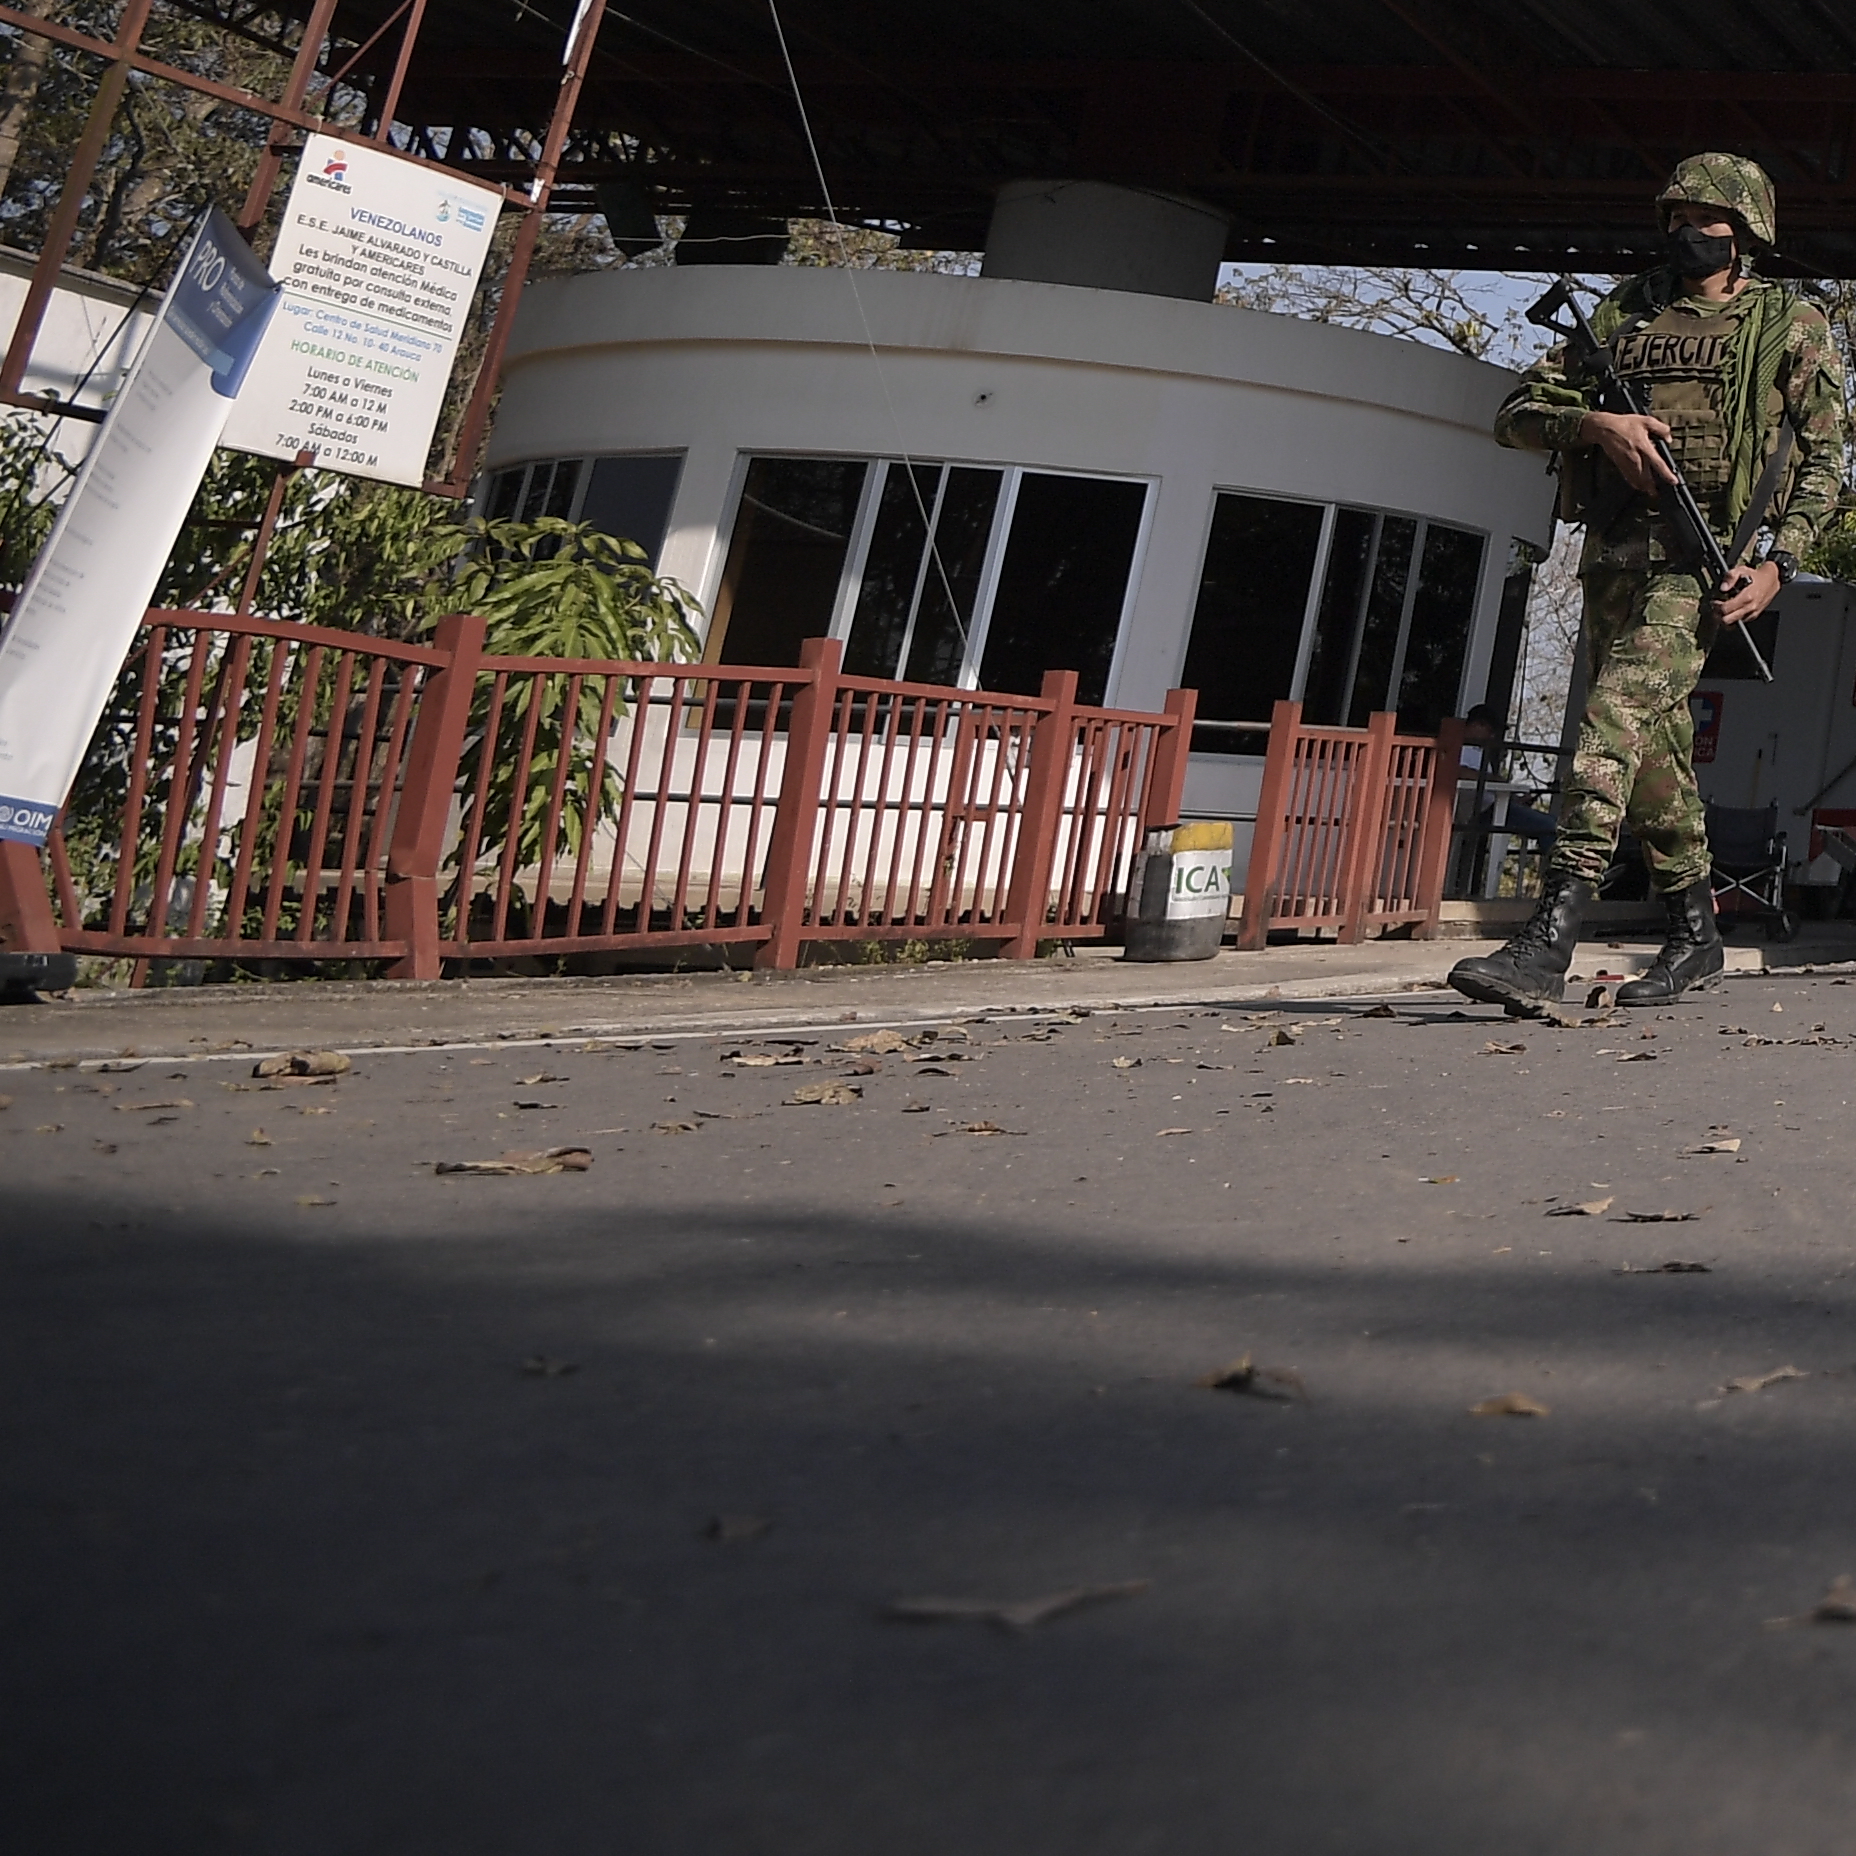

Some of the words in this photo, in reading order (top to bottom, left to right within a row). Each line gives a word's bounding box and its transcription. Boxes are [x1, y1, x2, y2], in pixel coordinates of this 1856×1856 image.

[307, 175, 351, 194] americares
[351, 207, 442, 246] VENEZOLANOS
[188, 239, 226, 292] PRO
[332, 226, 365, 242] JAIME
[367, 236, 420, 259] ALVARADO
[424, 253, 430, 262] Y
[431, 256, 471, 276] CASTILLA
[352, 245, 359, 254] Y
[360, 248, 424, 275] AMERICARES
[293, 262, 341, 282] gratuita
[343, 276, 363, 287] por
[366, 283, 411, 302] consulta
[299, 244, 318, 258] Les
[322, 250, 367, 272] brindan
[370, 267, 417, 288] atención
[420, 281, 457, 301] Médica
[284, 277, 308, 290] con
[311, 284, 357, 304] entrega
[360, 297, 375, 308] de
[378, 303, 452, 332] medicamentos
[316, 310, 347, 326] Centro
[350, 321, 361, 329] de
[364, 323, 389, 337] Salud
[304, 322, 328, 335] Calle
[390, 346, 421, 361] Arauca
[291, 340, 345, 362] HORARIO
[348, 355, 363, 367] DE
[365, 360, 419, 382] ATENCIÓN
[308, 366, 340, 384] Lunes
[343, 378, 350, 386] a
[355, 378, 392, 397] Viernes
[303, 383, 327, 399] 7:00
[328, 391, 348, 404] AM
[351, 399, 358, 407] a
[376, 403, 387, 413] M
[289, 399, 314, 414] 2:00
[316, 406, 333, 419] PM
[336, 413, 343, 422] a
[346, 414, 369, 428] 6:00
[371, 419, 388, 431] PM
[308, 423, 358, 444] Sábados
[276, 434, 299, 449] 7:00
[301, 440, 321, 455] AM
[324, 448, 332, 456] a
[336, 448, 365, 463] 12:00
[366, 456, 377, 466] M
[13, 809, 54, 831] OIM
[1175, 865, 1220, 894] ICA
